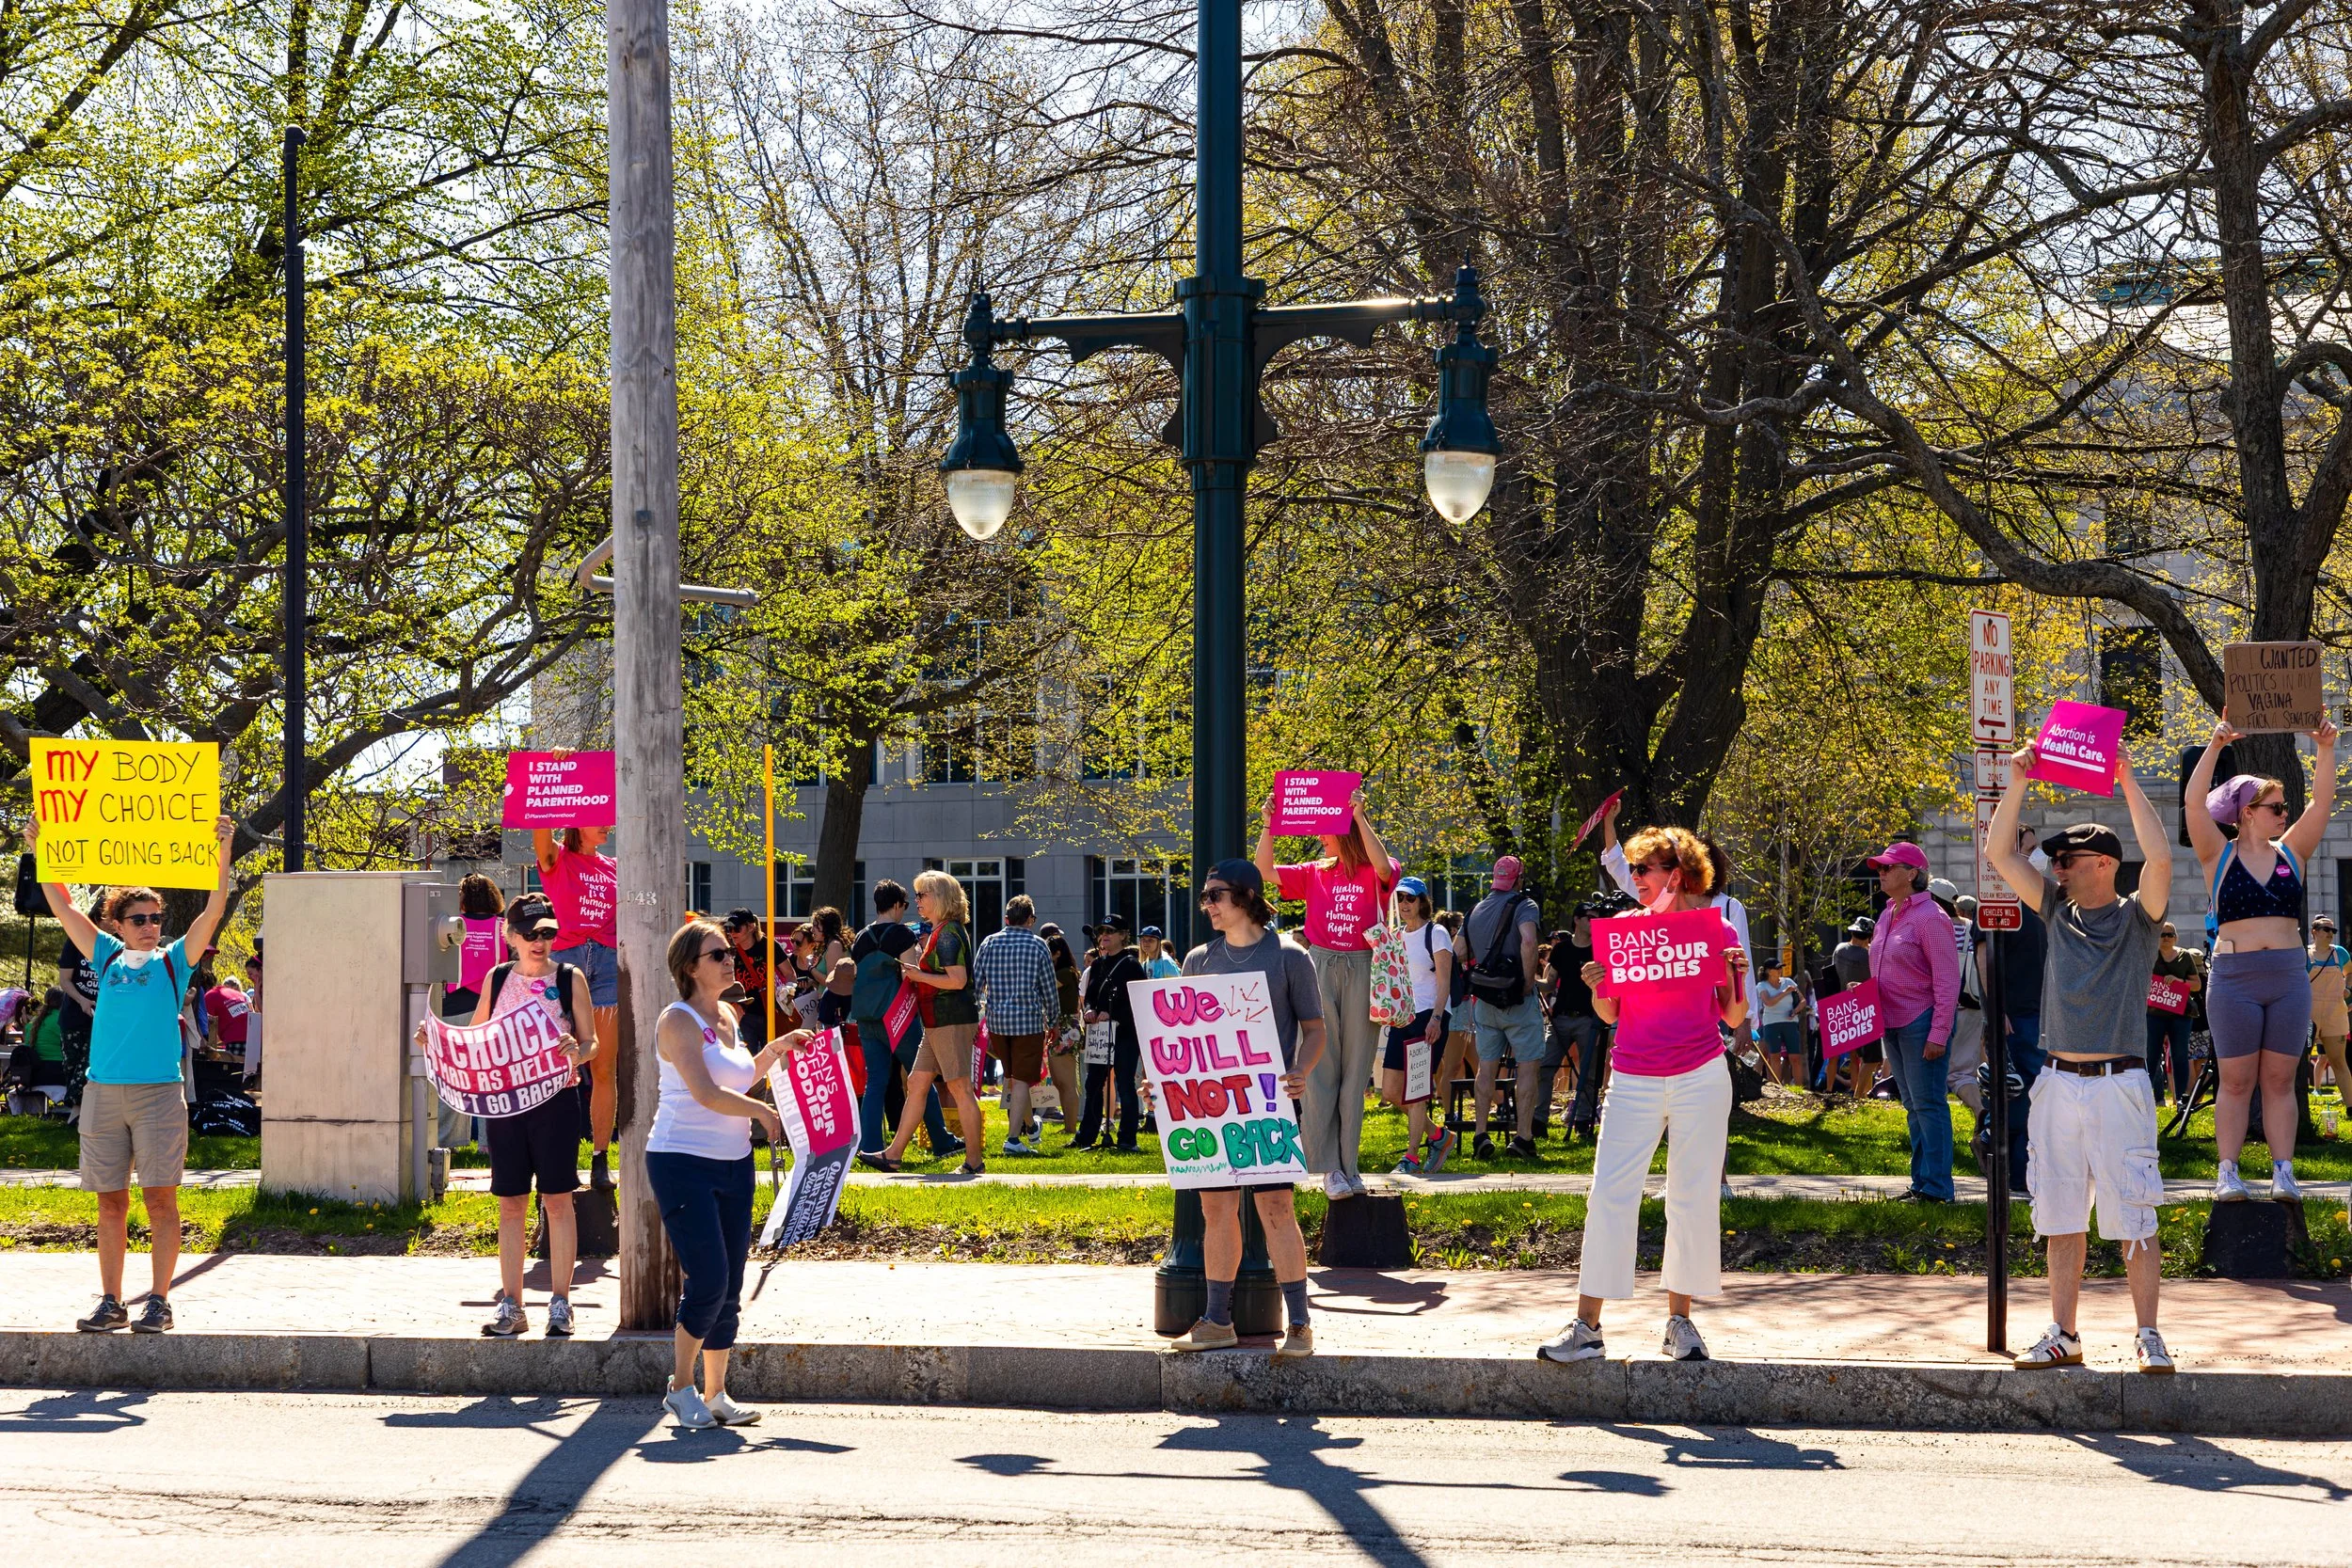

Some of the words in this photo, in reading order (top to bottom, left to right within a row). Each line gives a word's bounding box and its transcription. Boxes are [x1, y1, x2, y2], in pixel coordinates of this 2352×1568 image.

[1983, 623, 1997, 647] NO
[1974, 650, 2010, 678] PARKING
[2229, 647, 2243, 670] IF
[2260, 647, 2317, 670] WANTED
[1984, 679, 2000, 696] ANY
[2229, 673, 2277, 694] POLITICS
[2281, 673, 2294, 690] IN
[2298, 673, 2313, 689] MY
[1983, 699, 2002, 716] TIME
[2248, 692, 2293, 711] VAGINA
[2247, 711, 2271, 730] FUCK
[2272, 712, 2277, 729] A
[2283, 710, 2321, 729] SENATOR
[2047, 723, 2086, 742] Abortion
[2088, 731, 2096, 744] is
[2042, 737, 2076, 755] Health
[2078, 746, 2106, 763] Care.
[111, 752, 200, 784] BODY
[529, 762, 533, 771] I
[536, 761, 578, 772] STAND
[1980, 756, 2010, 768] TOW-AWAY
[529, 774, 562, 784] WITH
[1290, 778, 1319, 786] STAND
[1987, 773, 2003, 783] ZONE
[527, 784, 583, 796] PLANNED
[1285, 787, 1307, 796] WITH
[100, 793, 209, 823] CHOICE
[526, 795, 609, 808] PARENTHOOD
[1282, 807, 1342, 816] PARENTHOOD
[46, 840, 89, 864] NOT
[99, 838, 162, 866] GOING
[170, 842, 220, 867] BACK
[580, 873, 612, 883] Health
[1332, 883, 1364, 894] Health
[580, 895, 612, 909] Human
[1346, 903, 1353, 911] a
[580, 907, 608, 921] Right.
[1326, 911, 1360, 922] Human
[2004, 909, 2015, 917] WILL
[1327, 922, 1357, 937] Right.
[1609, 928, 1669, 949] BANS
[1609, 948, 1652, 967] OFF
[1656, 941, 1709, 962] OUR
[1613, 959, 1701, 984] BODIES
[2150, 987, 2162, 995] FF
[2163, 990, 2183, 1002] OUR
[2152, 981, 2169, 991] ANS
[1152, 986, 1225, 1027] We
[1827, 998, 1858, 1021] BANS
[2150, 994, 2177, 1007] ODIES
[1828, 1014, 1851, 1033] OFF
[1852, 1005, 1876, 1024] OUR
[446, 1004, 561, 1070] CHOICE
[1830, 1019, 1873, 1047] BODIES
[1150, 1030, 1272, 1075] WILL
[439, 1058, 470, 1091] MAD
[477, 1069, 503, 1092] AS
[509, 1051, 568, 1087] HELL.
[815, 1036, 838, 1095] BANS
[437, 1079, 480, 1114] WON'T
[485, 1092, 512, 1115] GO
[516, 1073, 569, 1110] BACK!
[793, 1050, 824, 1132] BODIES
[805, 1041, 824, 1082] OFF
[816, 1085, 835, 1137] OUR
[1168, 1127, 1218, 1161] GO
[1221, 1117, 1307, 1169] BACK
[803, 1188, 832, 1241] BODIES
